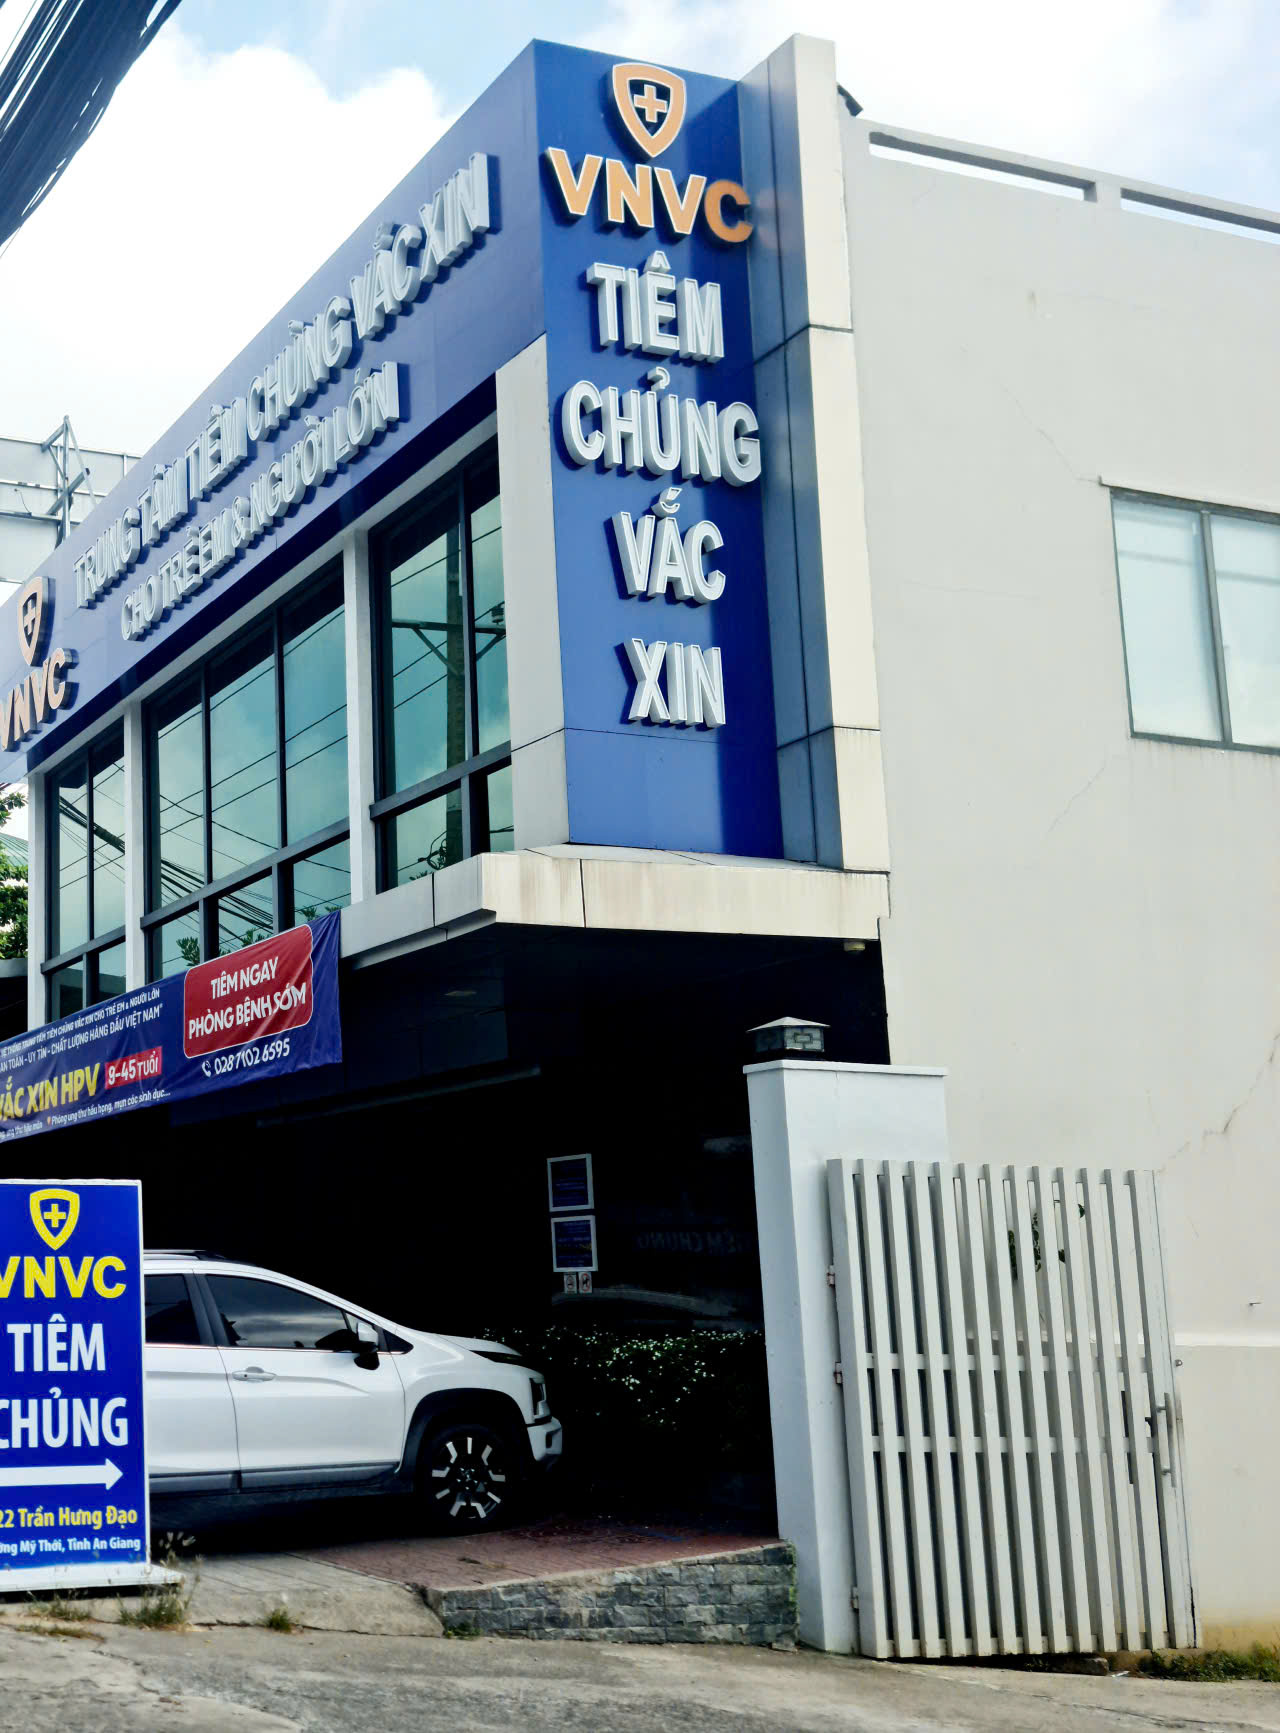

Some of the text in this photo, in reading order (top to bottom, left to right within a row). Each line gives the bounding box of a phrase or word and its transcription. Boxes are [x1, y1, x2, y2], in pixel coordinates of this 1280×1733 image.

[547, 147, 753, 243] VNVC
[587, 250, 724, 363] TIÊM
[74, 152, 490, 609] TRUNG TÂM TIÊM CHỦNG VẮC XIN
[561, 366, 761, 487] CHỦNG
[121, 361, 400, 641] CHO TRẺ EM & NGƯỜI LỚN
[612, 487, 726, 603] VẮC
[624, 638, 726, 727] XIN
[211, 956, 279, 1000] TIÊM NGAY
[189, 982, 307, 1040] PHÒNG BỆNH SỚM
[108, 1050, 159, 1086] 9-45 TUỔI
[214, 1038, 290, 1075] 028 7102 6595
[26, 1076, 59, 1115] XIN
[61, 1062, 101, 1105] HPV
[7, 1313, 106, 1373] TIÊM
[18, 1505, 55, 1528] Trần
[58, 1506, 103, 1530] Hưng
[105, 1505, 138, 1530] Đạo
[20, 1540, 37, 1555] Mỹ
[93, 1538, 108, 1550] An
[109, 1537, 141, 1552] Giang
